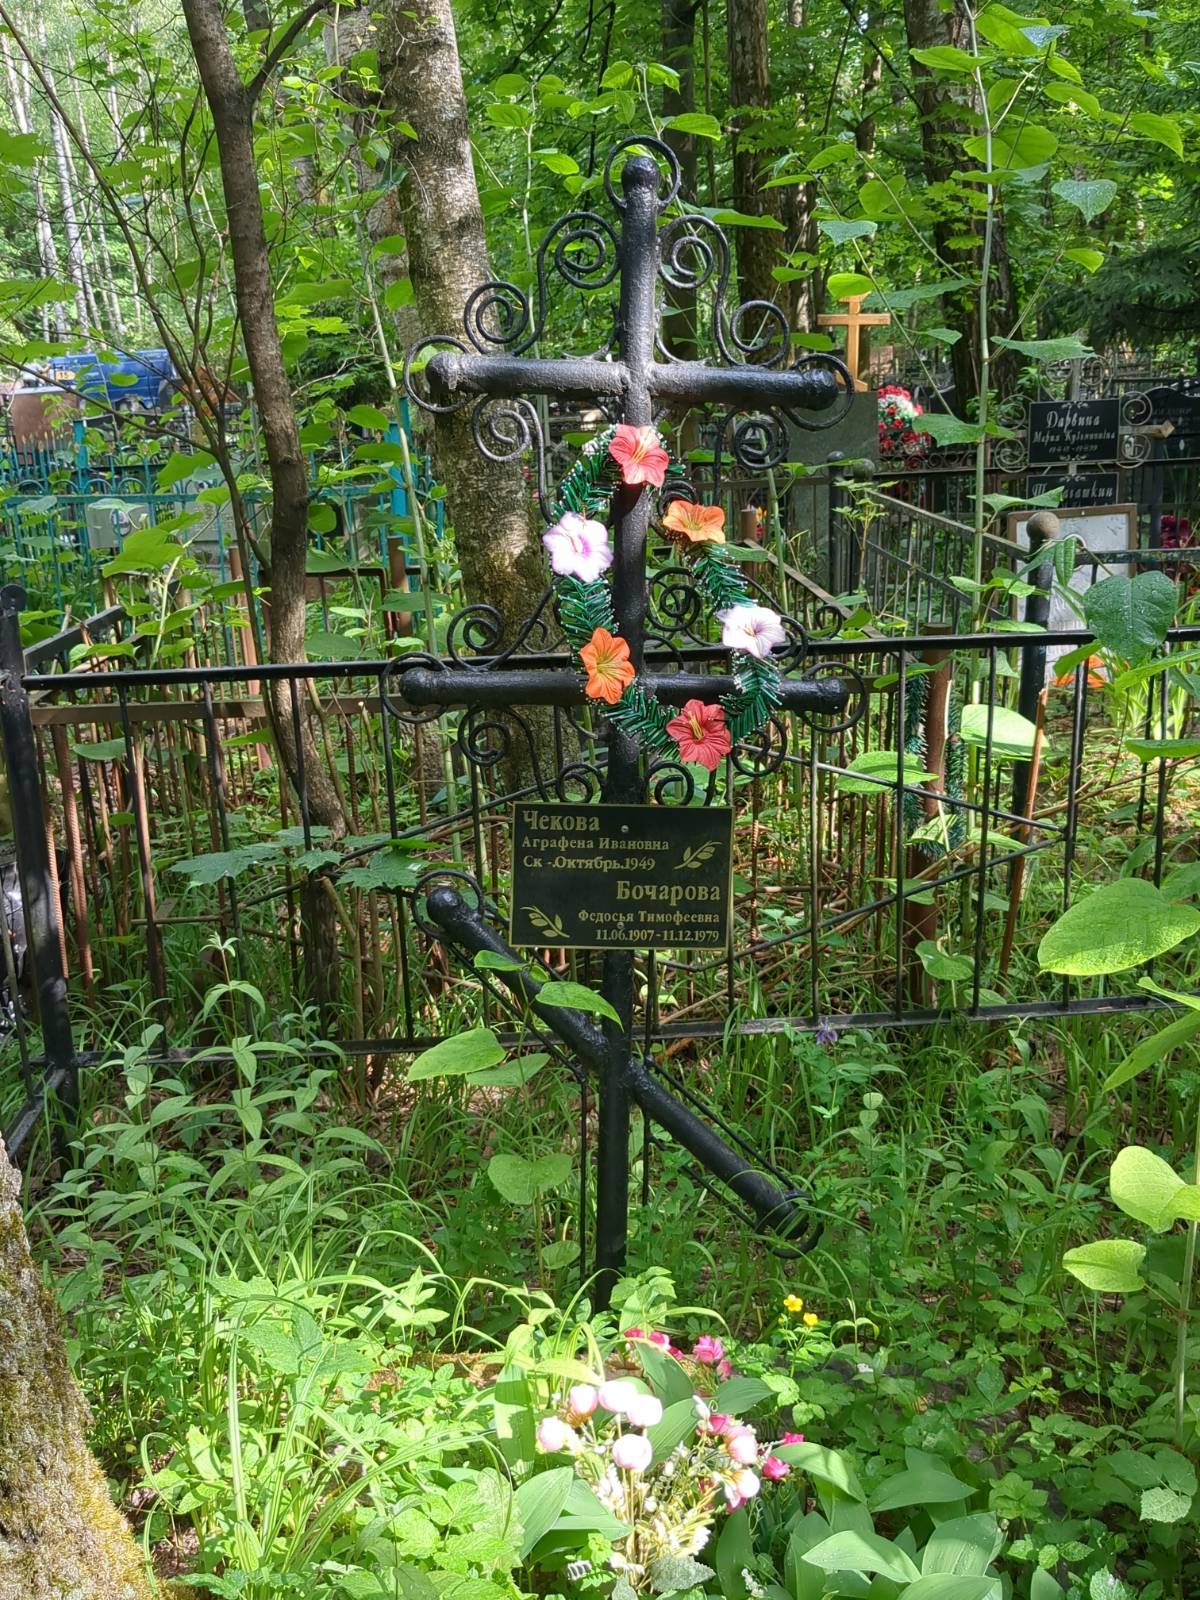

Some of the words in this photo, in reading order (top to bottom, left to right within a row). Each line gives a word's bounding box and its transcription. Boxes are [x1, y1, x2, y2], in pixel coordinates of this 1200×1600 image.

[522, 810, 601, 831] Чекова
[521, 836, 594, 851] Аграфена
[598, 837, 669, 850] Ивановна
[616, 880, 721, 907] Бочарова
[578, 909, 634, 923] Федосья
[638, 910, 720, 925] Тимофеевна
